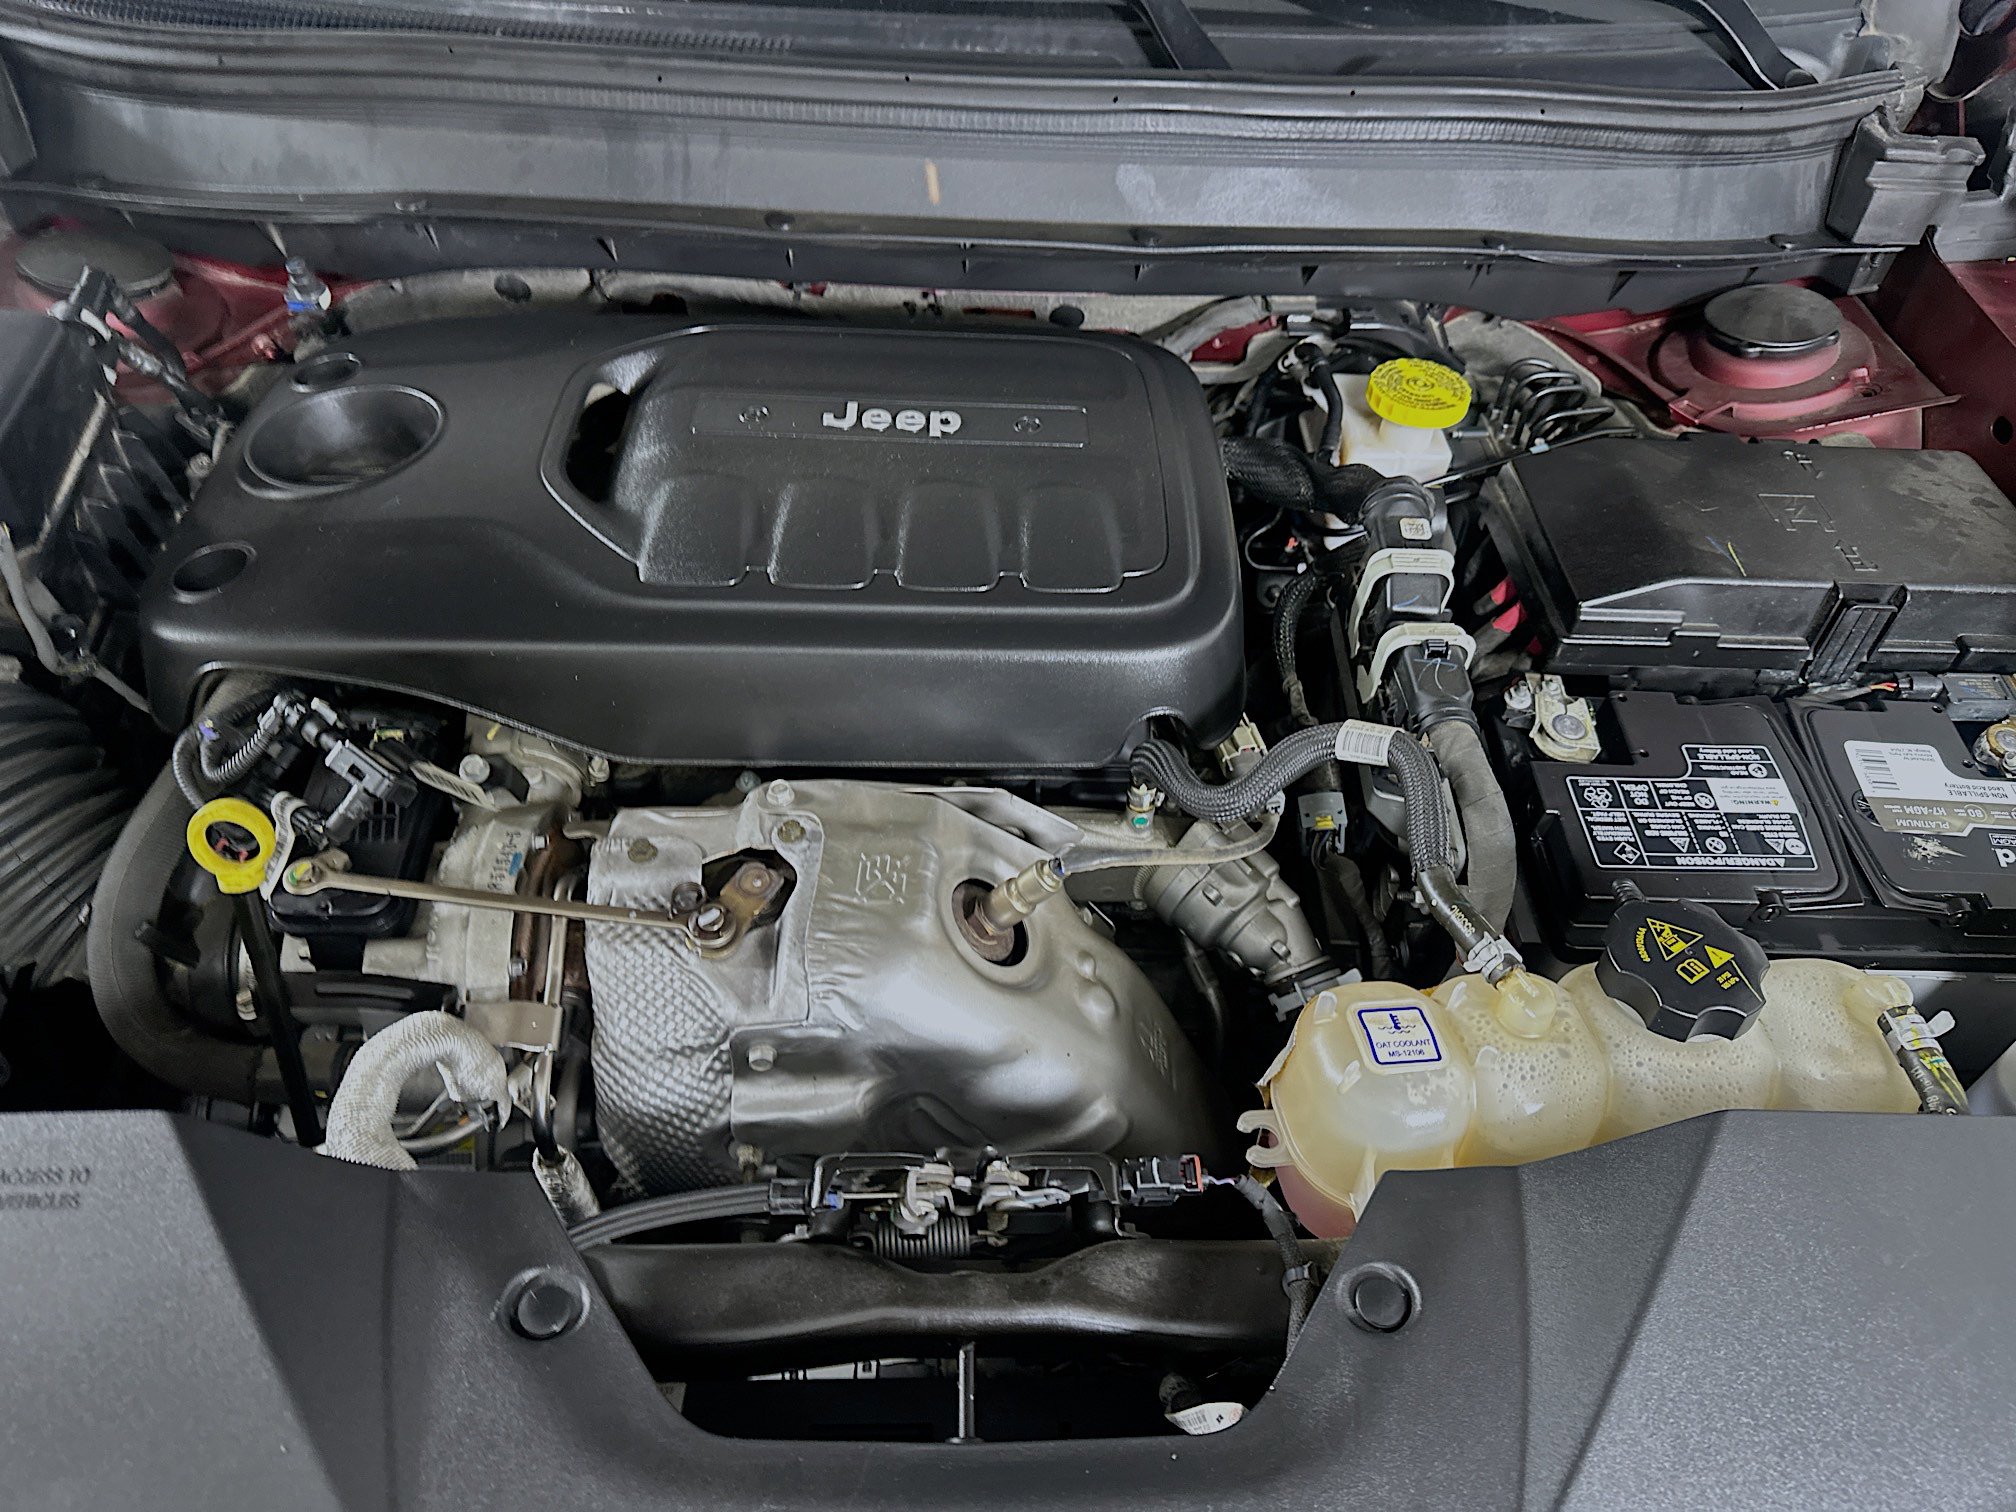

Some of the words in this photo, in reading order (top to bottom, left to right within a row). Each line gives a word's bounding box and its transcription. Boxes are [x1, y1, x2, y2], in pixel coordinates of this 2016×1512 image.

[823, 401, 961, 438] Jeep
[1947, 790, 2008, 798] NON-SPILLABLE
[1904, 806, 1947, 815] H7-AGM
[1967, 809, 1983, 817] 80
[1896, 819, 1949, 828] PLATINUM
[1675, 857, 1777, 866] DANGER/POISON
[1393, 1039, 1430, 1047] COOLANT
[70, 1168, 91, 1184] TO
